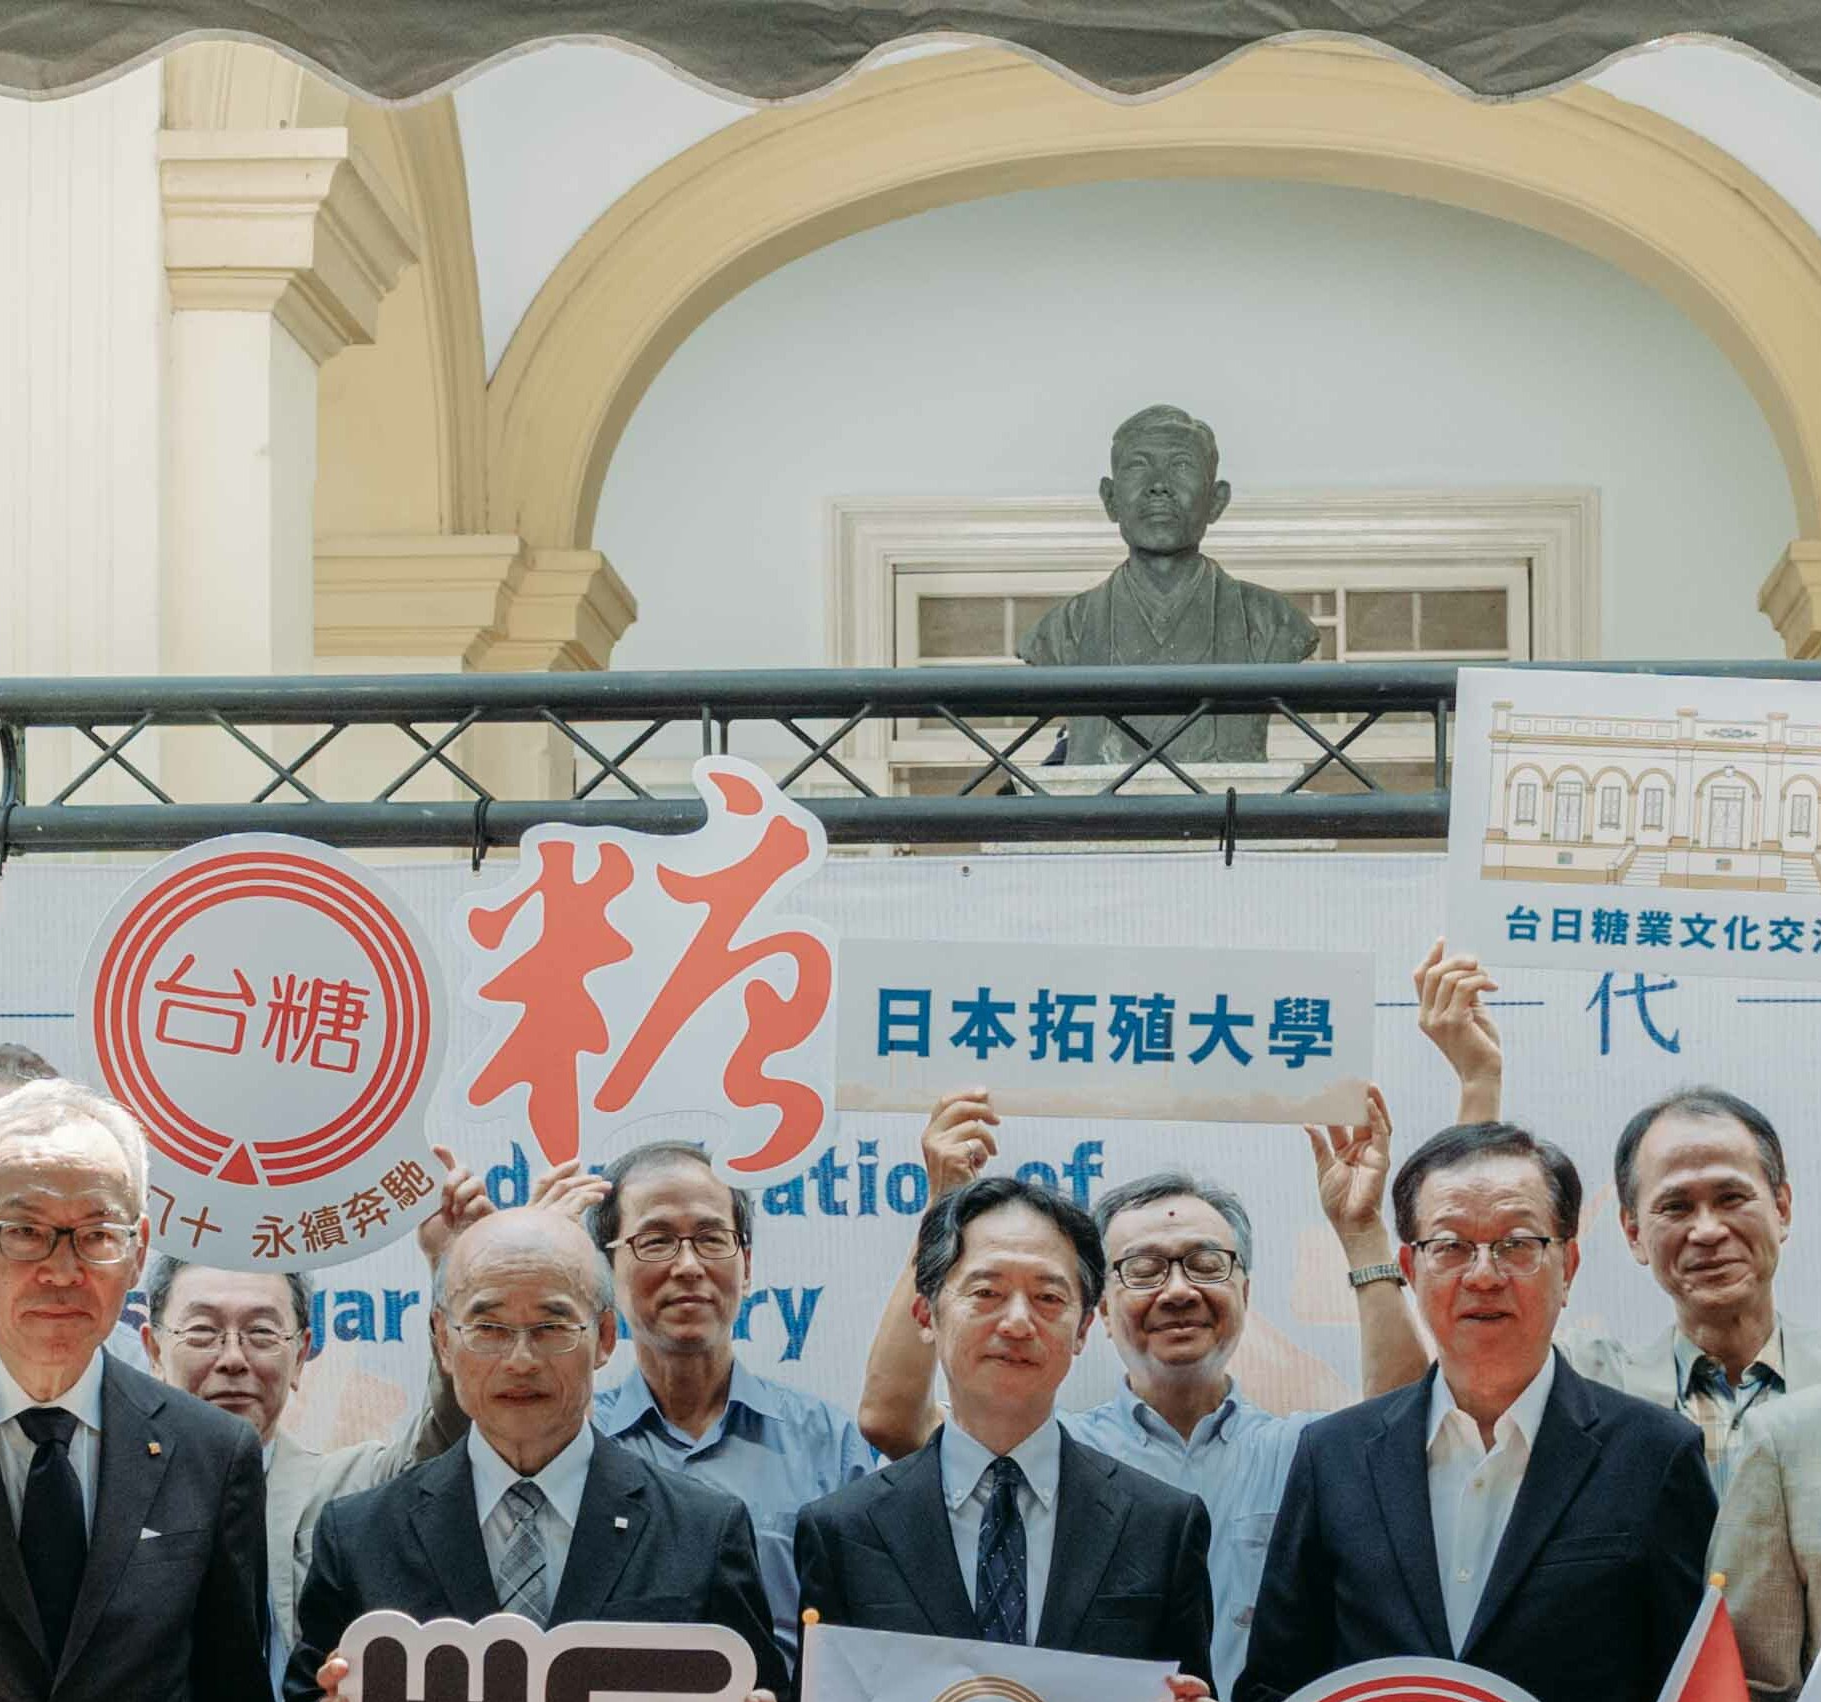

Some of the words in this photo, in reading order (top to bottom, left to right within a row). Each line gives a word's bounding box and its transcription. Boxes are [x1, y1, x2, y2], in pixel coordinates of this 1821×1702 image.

[154, 953, 371, 1074] 台糖
[876, 987, 1335, 1069] 日本拓殖大學
[252, 1159, 435, 1258] 永續奔馳
